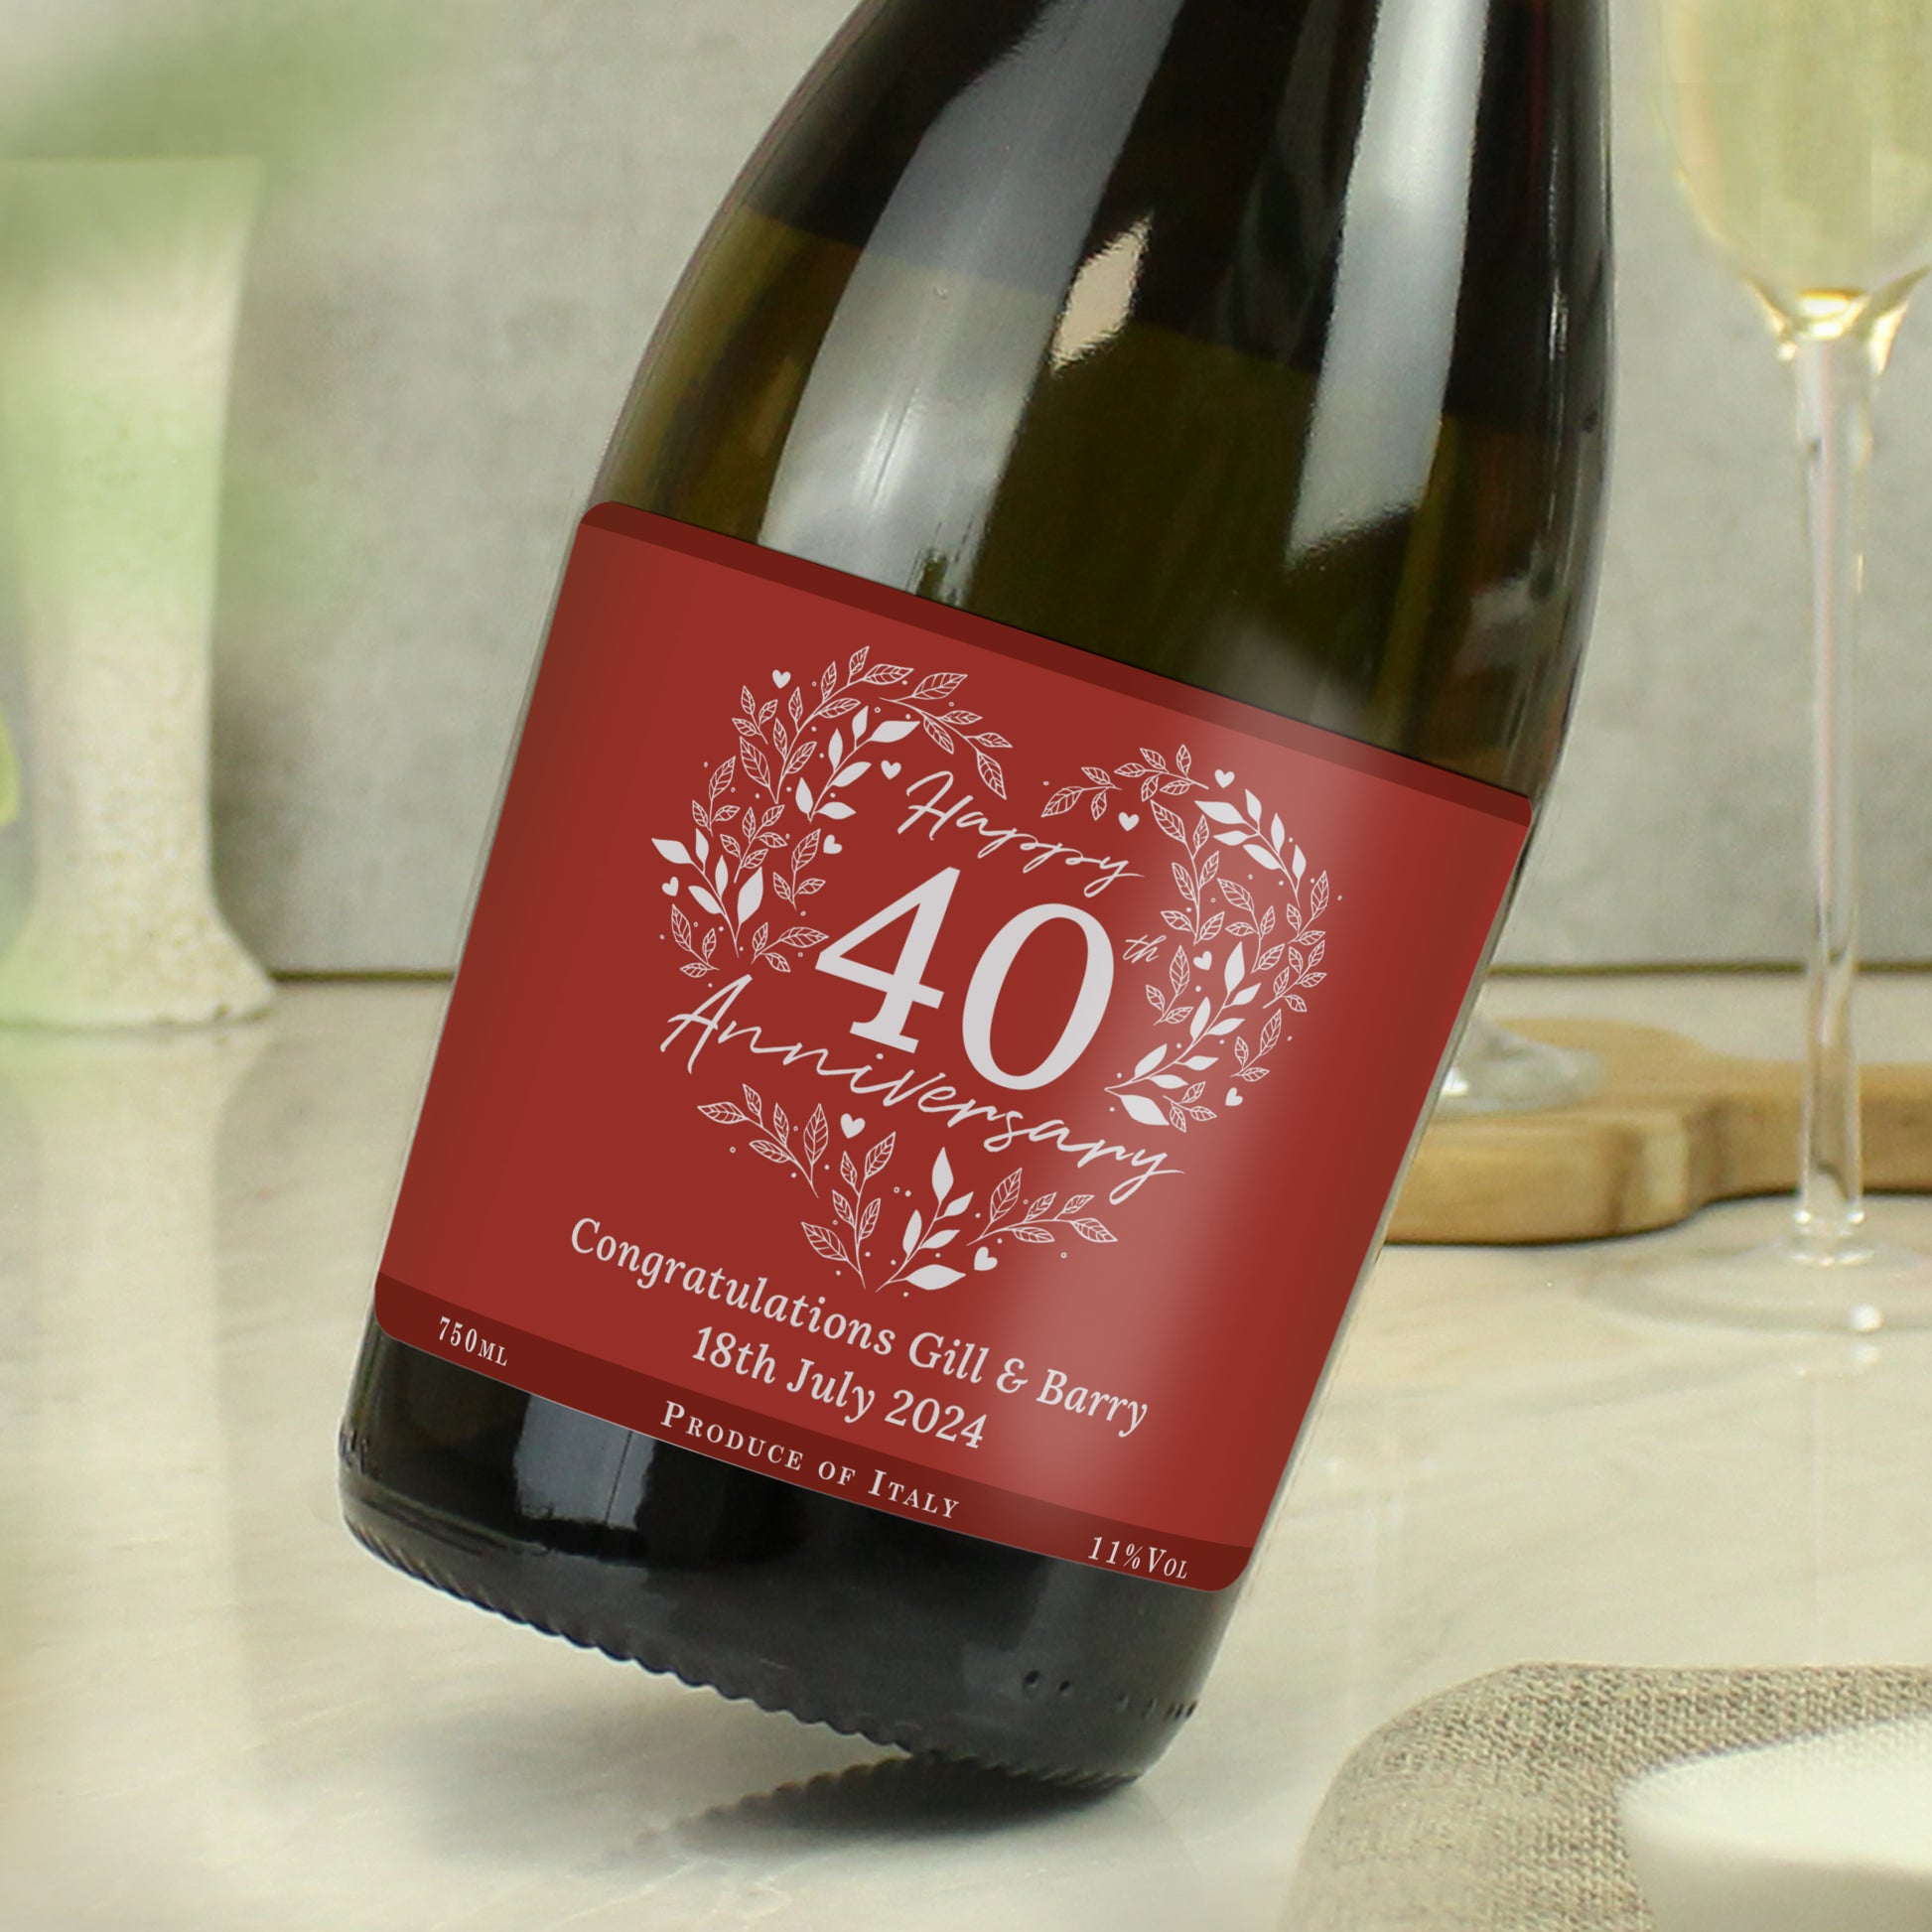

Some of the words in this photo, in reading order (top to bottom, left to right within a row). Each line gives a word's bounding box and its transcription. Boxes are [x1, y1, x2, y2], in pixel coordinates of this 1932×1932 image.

[897, 769, 1145, 898] Happy
[659, 973, 1185, 1205] Anniversary
[814, 866, 1115, 1091] 40
[571, 1217, 897, 1356] Congratulations
[908, 1331, 990, 1384] Gill
[996, 1357, 1029, 1394] &
[1035, 1368, 1148, 1439] Barry
[692, 1325, 776, 1384] 18th
[785, 1357, 876, 1424] July
[884, 1389, 987, 1449] 2024
